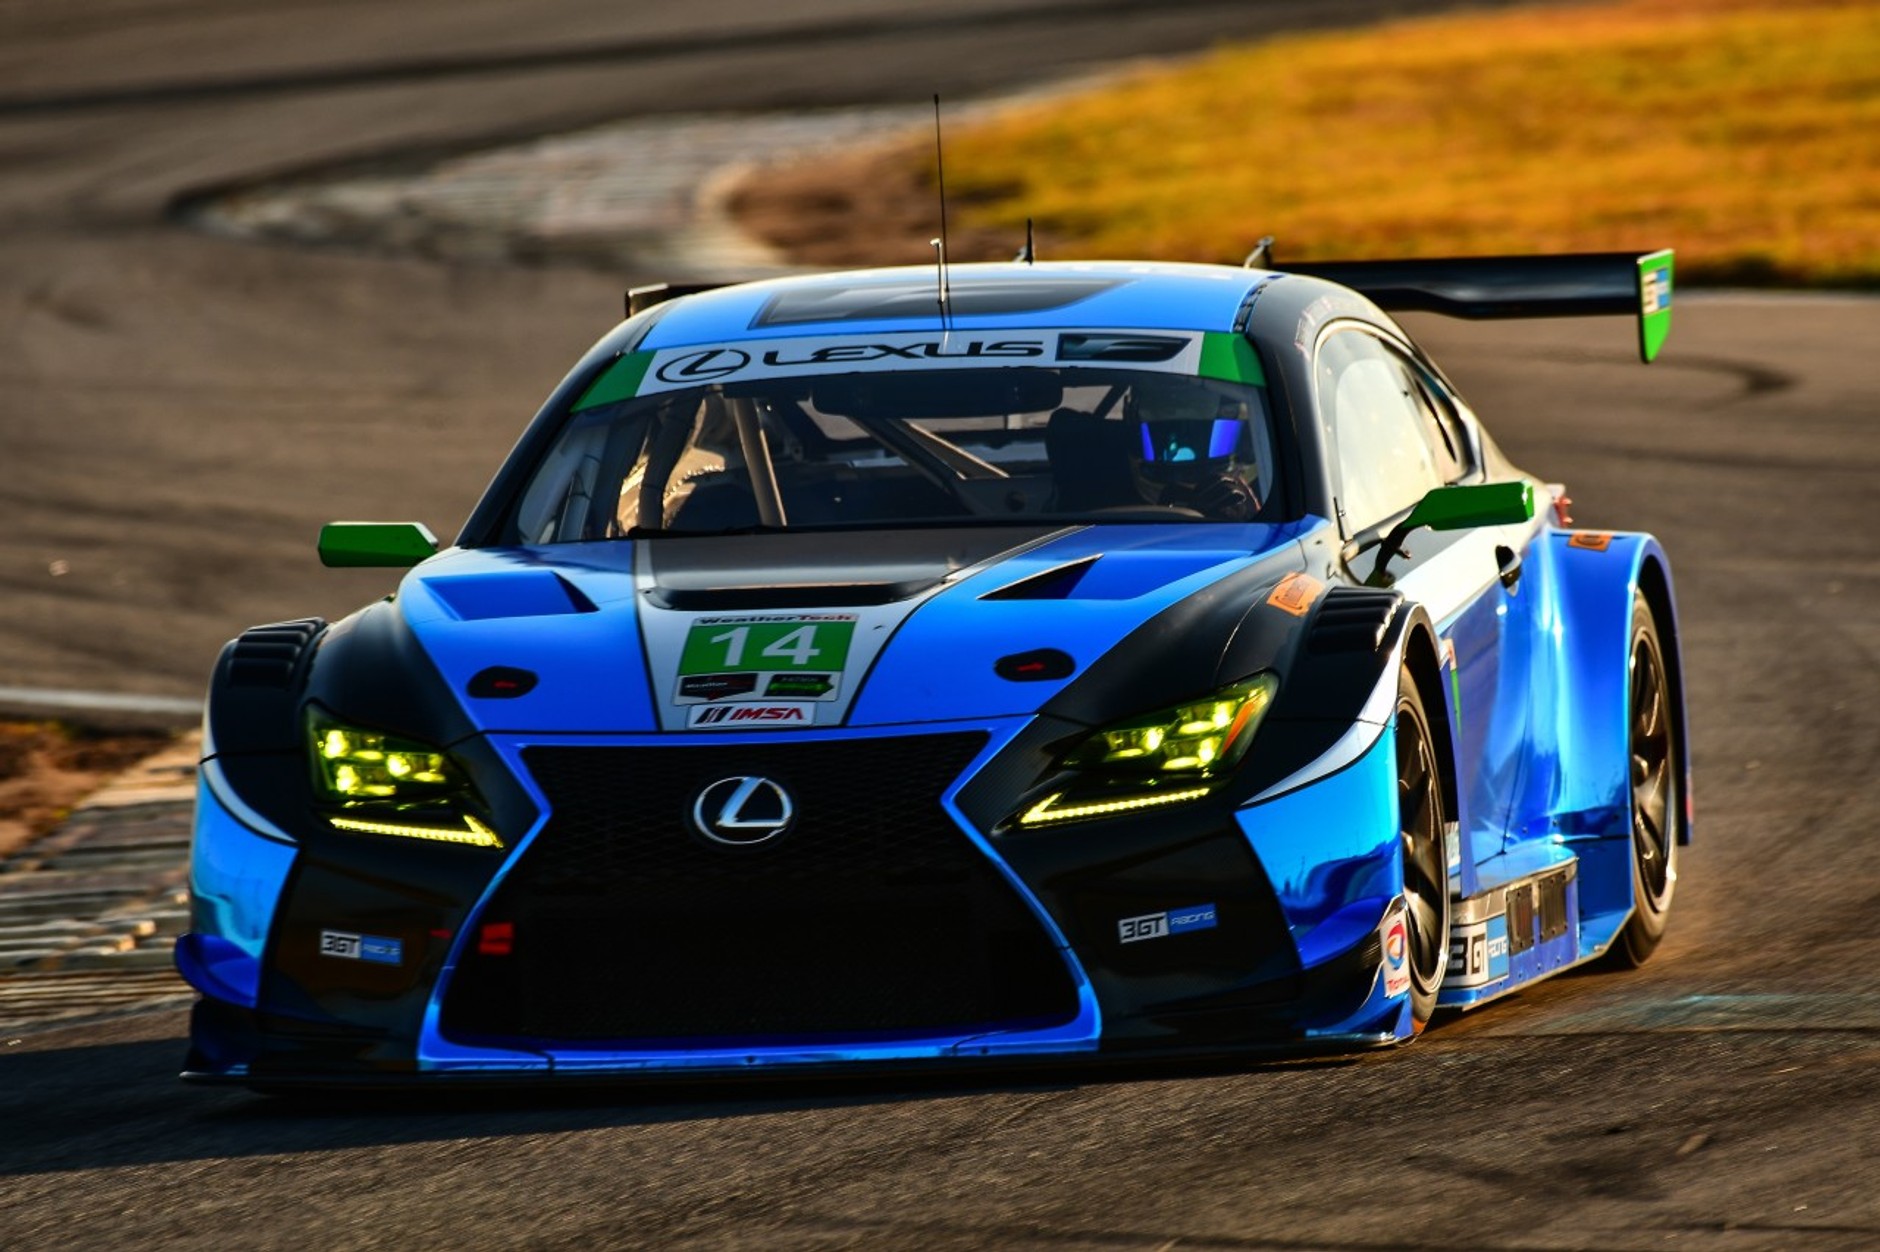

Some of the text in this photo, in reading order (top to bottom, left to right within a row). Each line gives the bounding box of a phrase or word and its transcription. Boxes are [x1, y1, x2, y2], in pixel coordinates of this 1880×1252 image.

[763, 341, 1044, 366] LEXUS
[700, 615, 851, 624] WeatherTech
[711, 625, 820, 666] 14
[728, 707, 805, 721] IMSA
[1122, 915, 1165, 939] 3GT
